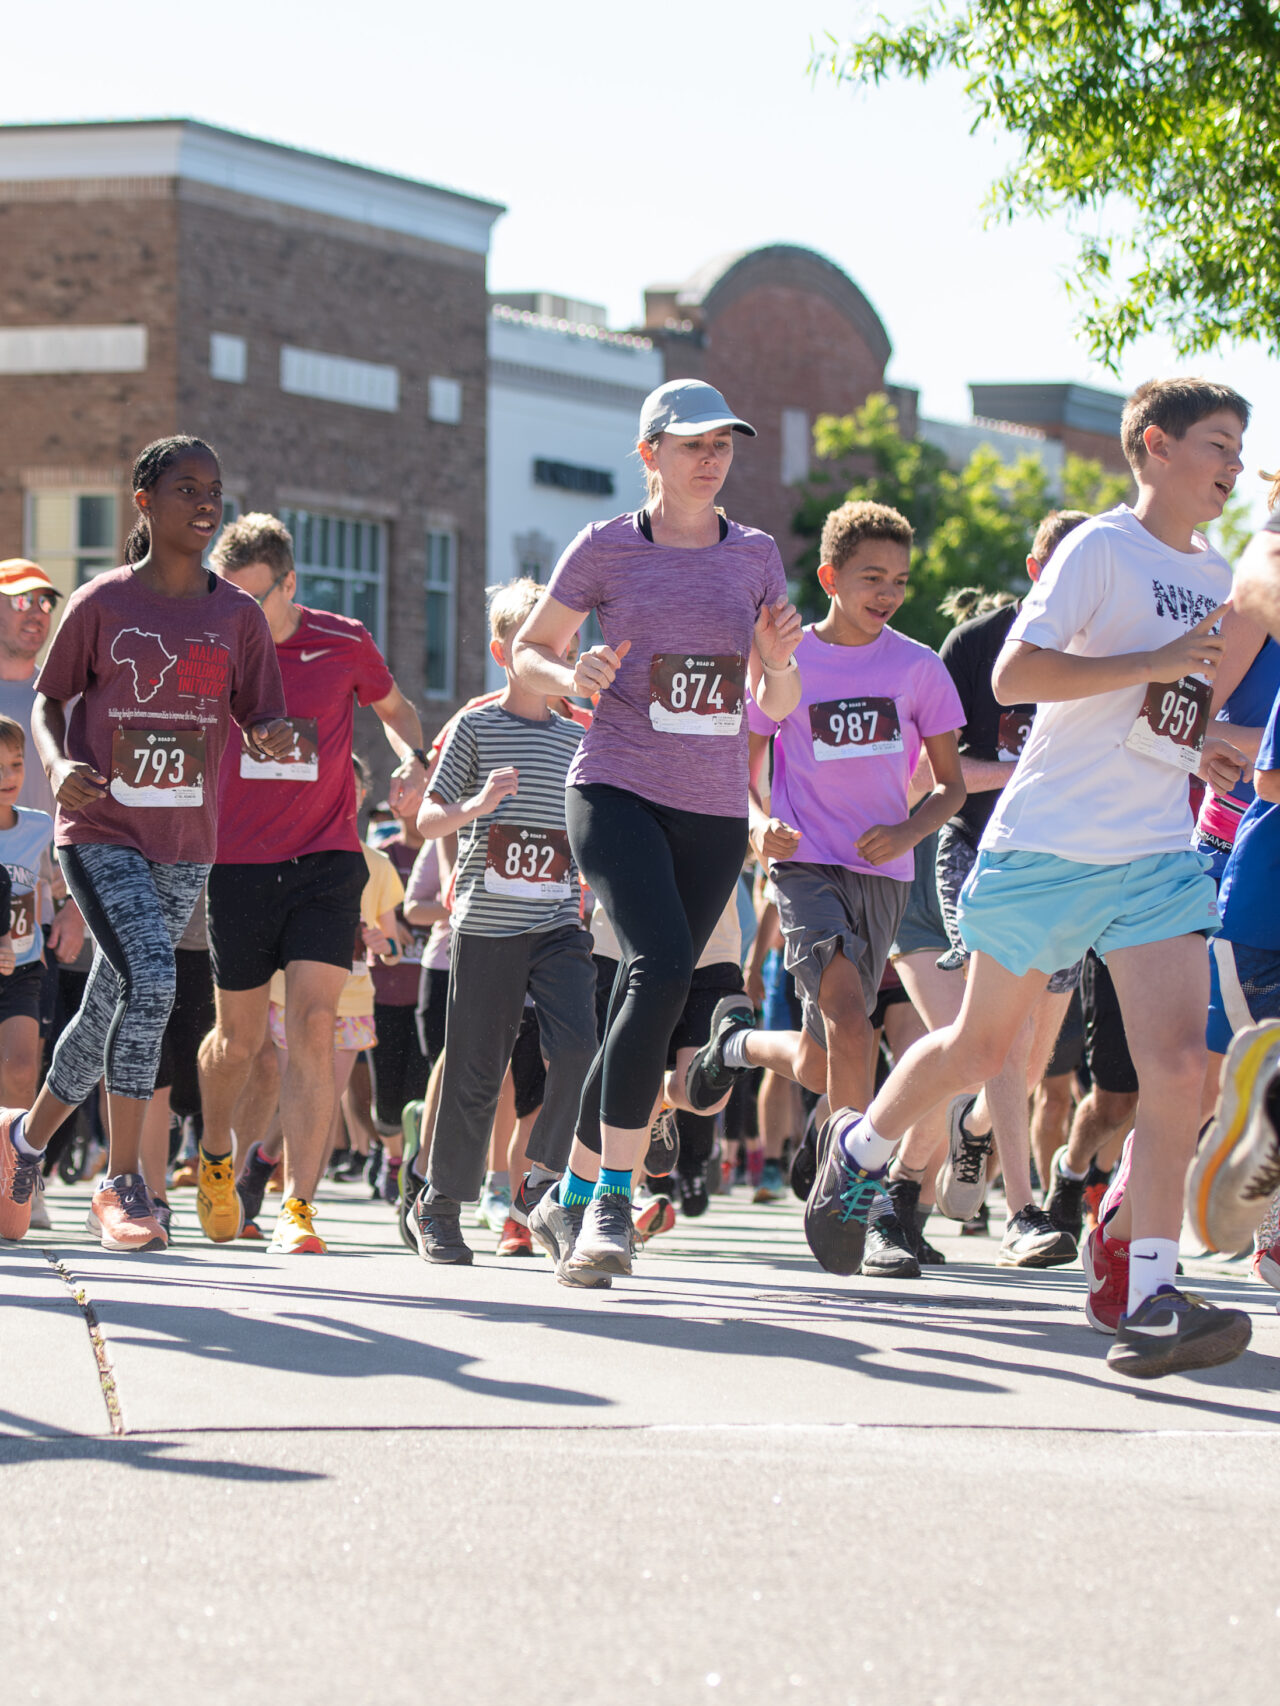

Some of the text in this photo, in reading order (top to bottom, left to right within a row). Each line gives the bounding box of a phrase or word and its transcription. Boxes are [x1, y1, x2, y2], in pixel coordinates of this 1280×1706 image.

[671, 672, 724, 710] 874
[829, 710, 878, 744] 987
[1158, 690, 1198, 740] 959
[134, 748, 185, 783] 793
[505, 842, 555, 878] 832
